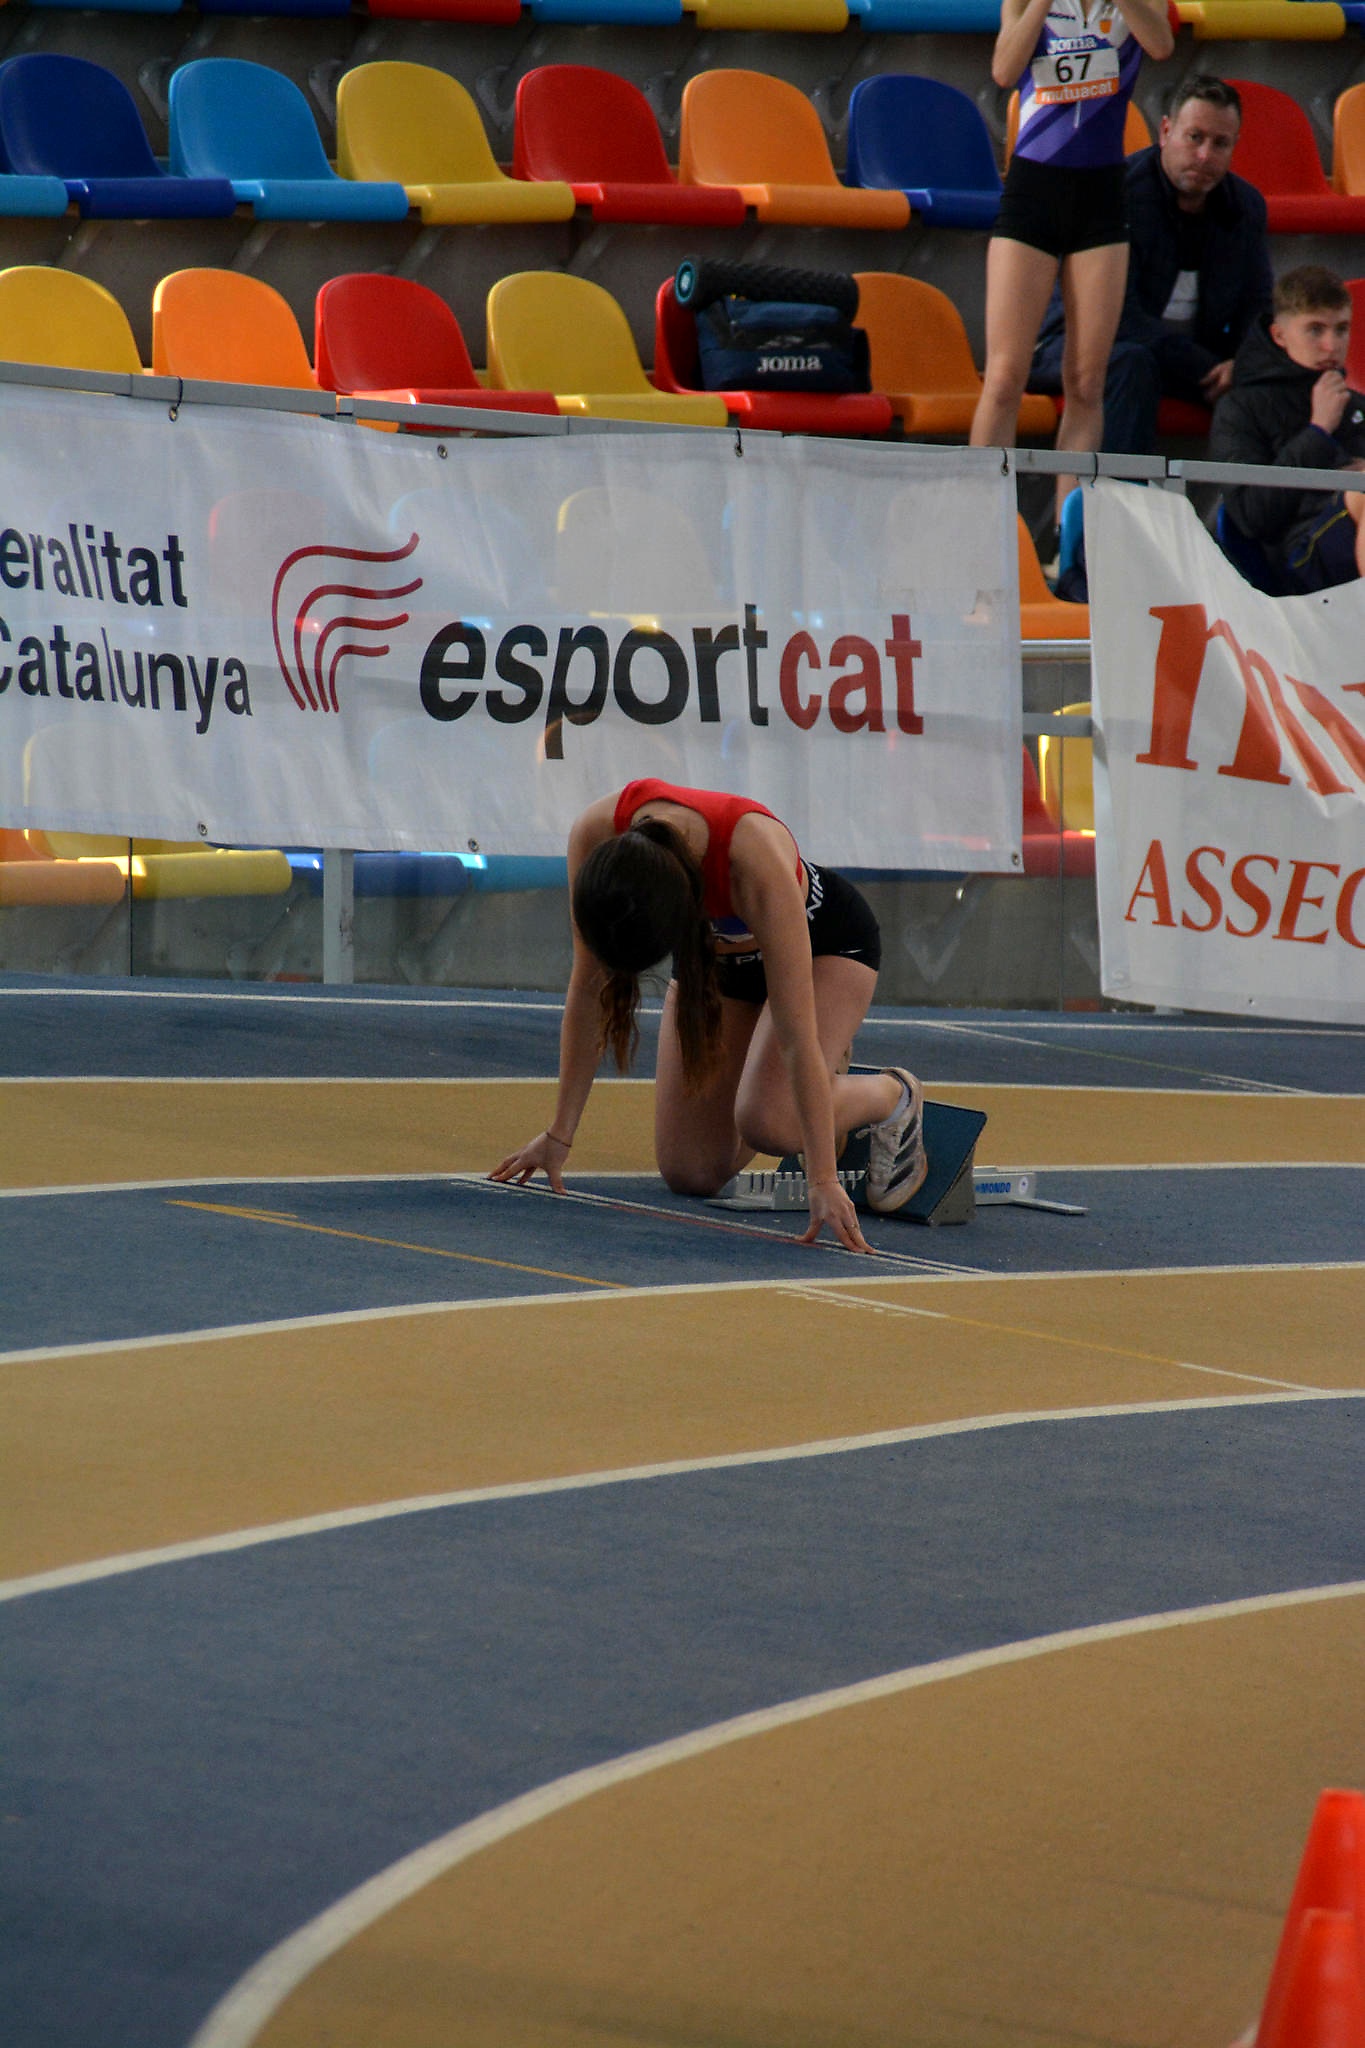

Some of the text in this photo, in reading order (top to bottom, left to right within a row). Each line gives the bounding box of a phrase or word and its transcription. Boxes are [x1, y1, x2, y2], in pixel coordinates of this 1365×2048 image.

[1056, 53, 1092, 83] 67
[1041, 80, 1113, 102] mutuacat
[419, 603, 924, 760] esportcat
